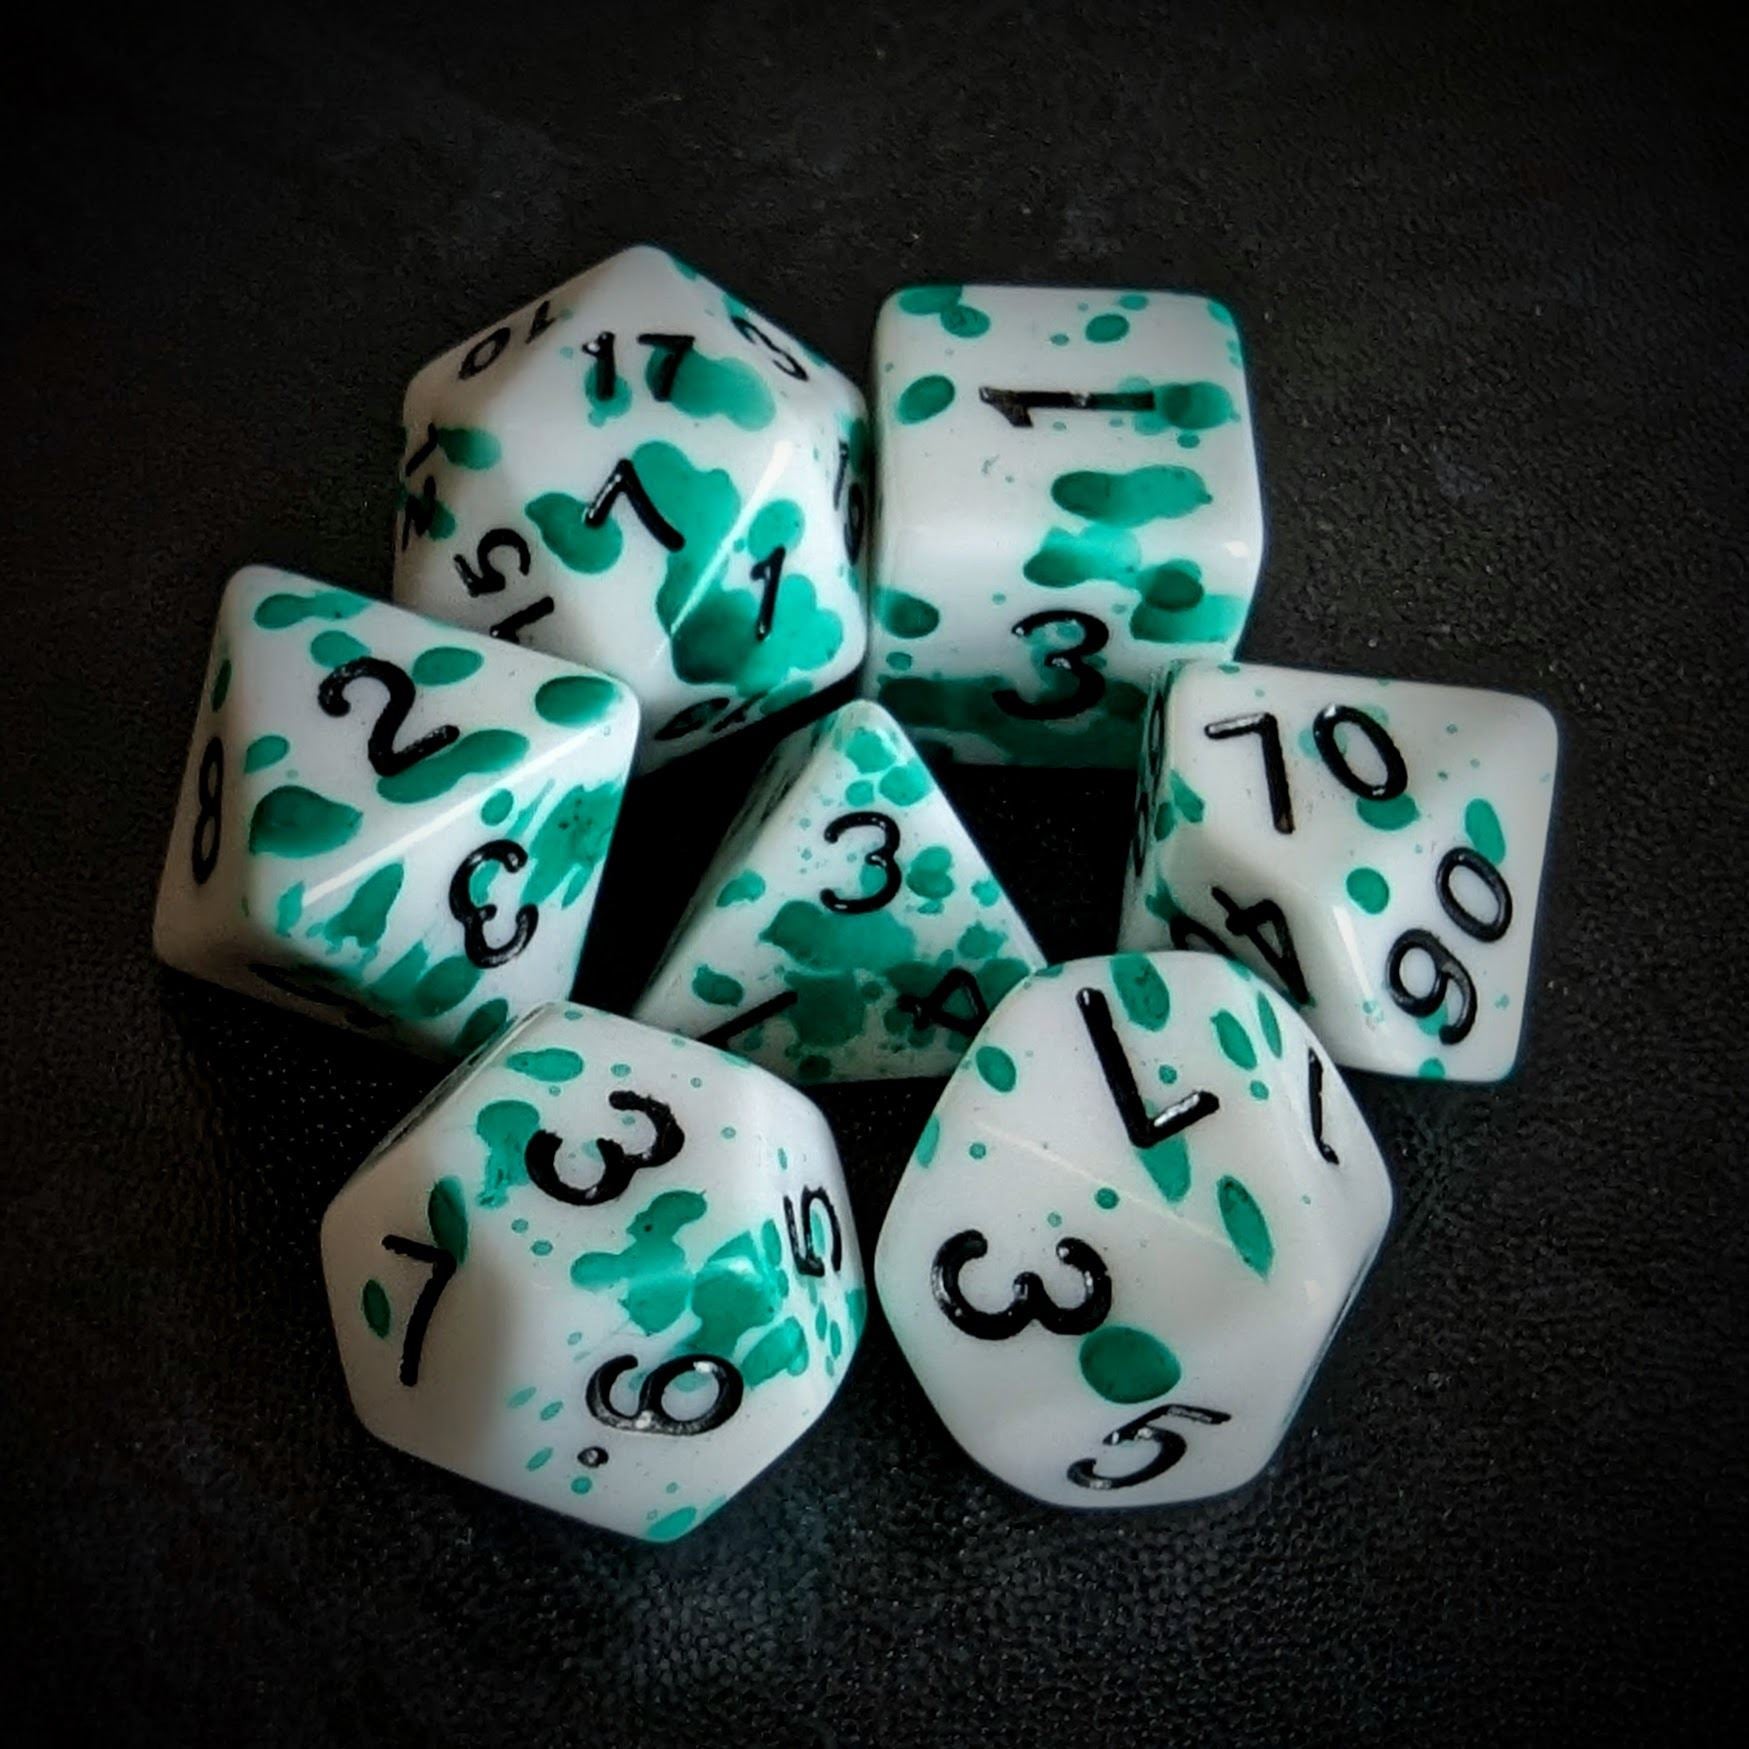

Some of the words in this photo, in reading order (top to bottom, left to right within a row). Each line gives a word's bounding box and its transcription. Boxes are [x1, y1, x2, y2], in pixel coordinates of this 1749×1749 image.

[582, 332, 695, 401] 17
[979, 387, 1154, 427] 1
[582, 460, 685, 551] 7
[454, 529, 554, 643] 15
[751, 546, 785, 640] 1
[318, 657, 459, 776] 2
[993, 611, 1108, 719] 3
[192, 737, 223, 884] 8
[1204, 704, 1408, 834] 70
[450, 839, 538, 968] 3
[821, 812, 901, 913] 3
[1386, 847, 1512, 1045] 90
[897, 968, 989, 1037] 4
[1076, 988, 1220, 1147] 7
[525, 1090, 684, 1205] 3
[784, 1186, 842, 1277] 5
[931, 1230, 1112, 1340] 3
[382, 1235, 456, 1386] 7
[1067, 1404, 1231, 1490] 5
